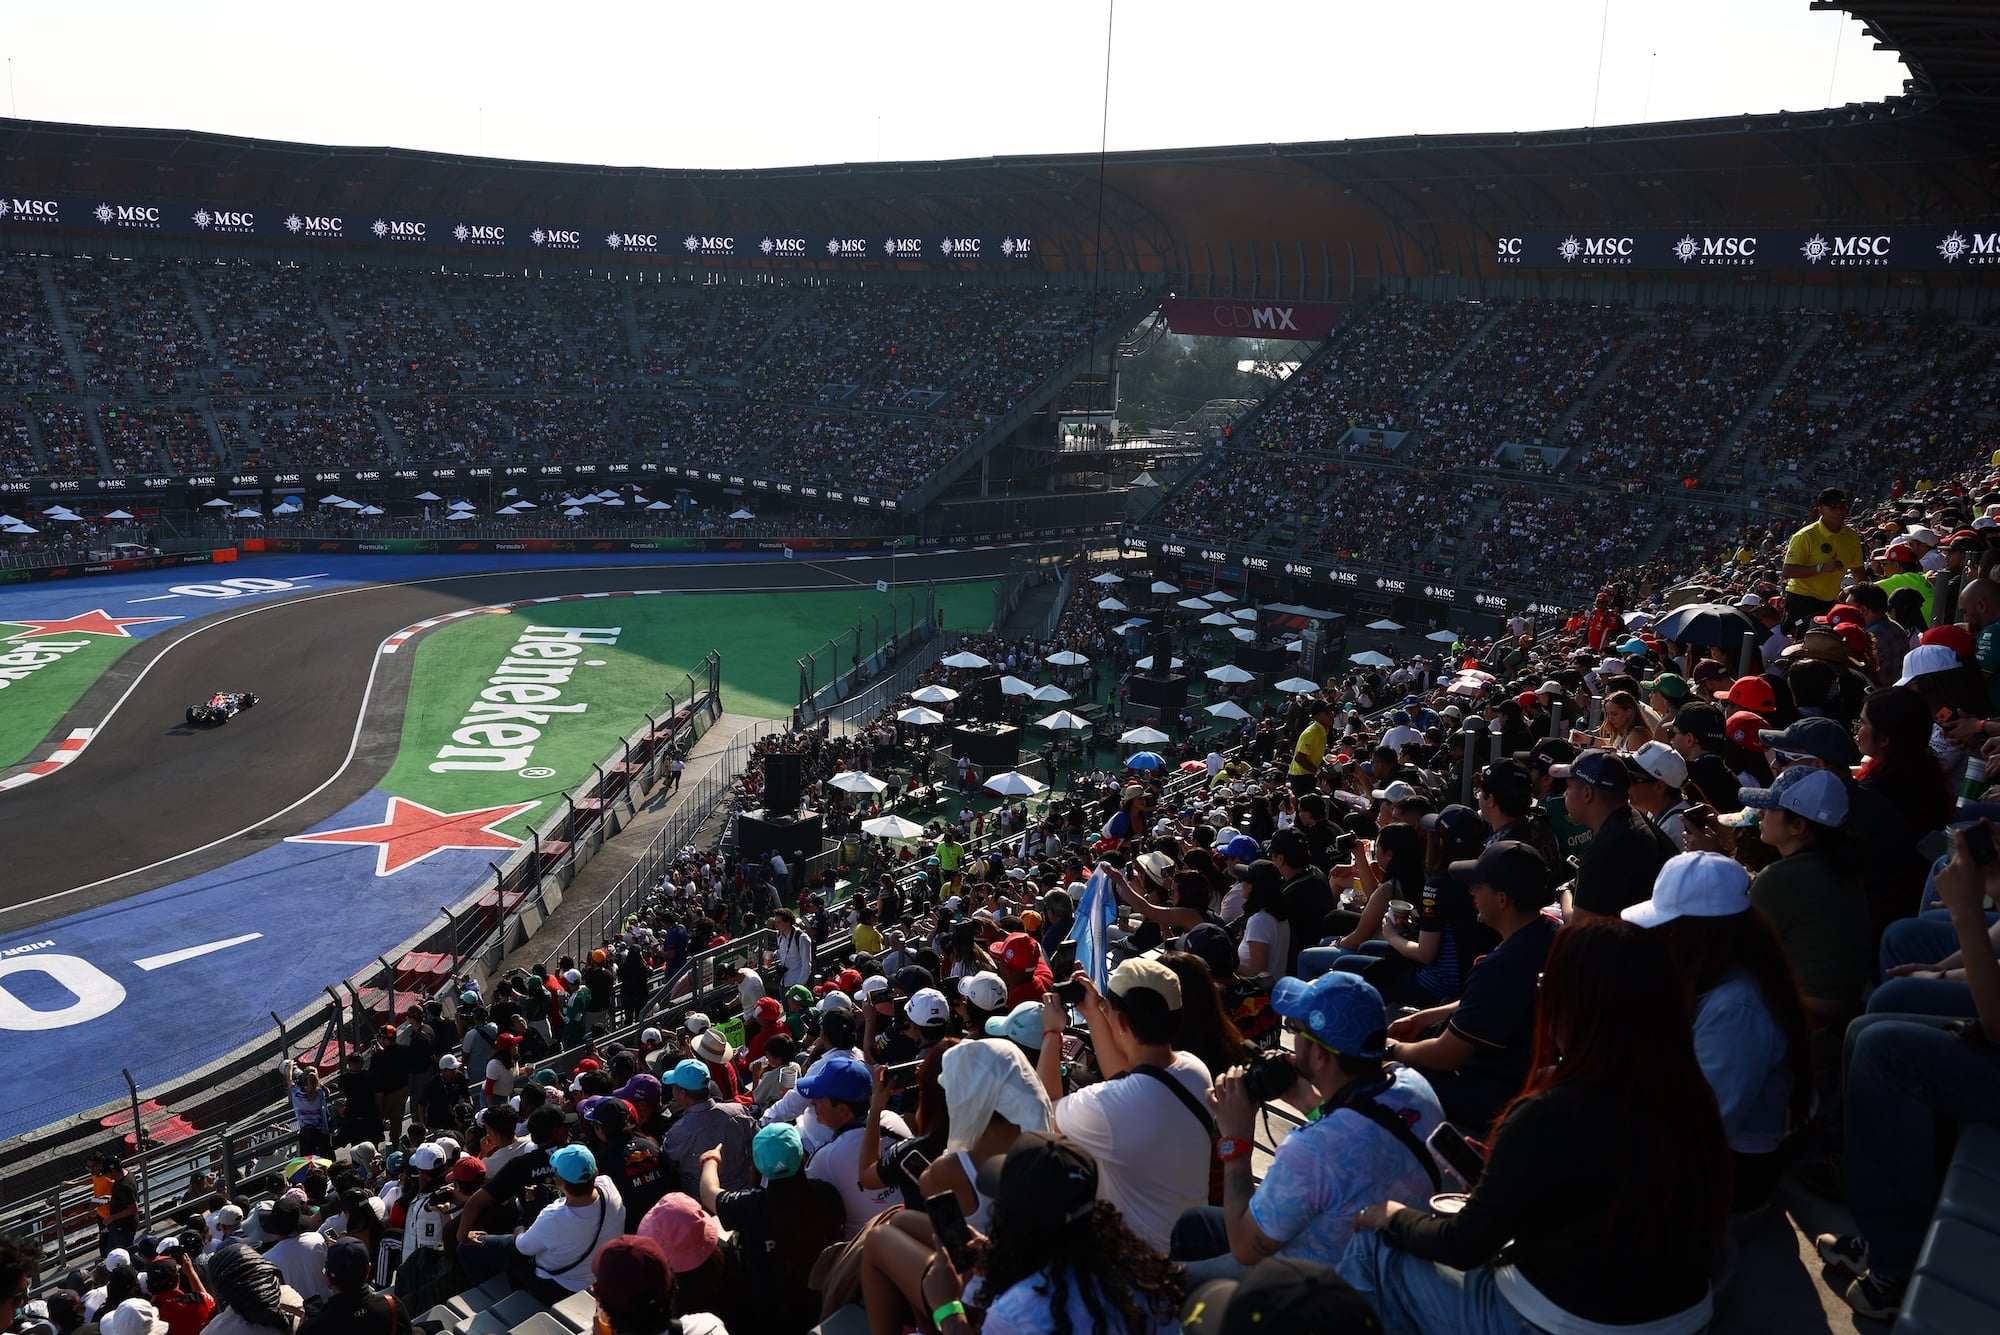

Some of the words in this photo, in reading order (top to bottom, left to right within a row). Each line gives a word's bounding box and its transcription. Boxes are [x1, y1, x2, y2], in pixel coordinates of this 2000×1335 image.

[13, 200, 58, 216] MSC
[117, 206, 160, 221] MSC
[14, 215, 60, 223] CRUISES
[214, 211, 254, 226] MSC
[305, 216, 342, 231] MSC
[118, 221, 161, 229] CRUISES
[390, 221, 426, 235] MSC
[471, 225, 505, 239] MSC
[547, 230, 580, 244] MSC
[624, 234, 657, 247] MSC
[701, 236, 734, 250] MSC
[775, 239, 805, 252] MSC
[841, 239, 866, 252] MSC
[897, 239, 921, 252] MSC
[954, 239, 981, 252] MSC
[1583, 238, 1634, 255] MSC
[1702, 237, 1756, 256] MSC
[1832, 236, 1891, 256] MSC
[1213, 305, 1297, 331] CDMX
[282, 474, 300, 482] MSC
[440, 469, 456, 477] MSC
[476, 468, 492, 476] MSC
[59, 481, 79, 489] MSC
[107, 479, 126, 487] MSC
[153, 478, 171, 486] MSC
[197, 477, 215, 485] MSC
[240, 475, 258, 483] MSC
[10, 482, 31, 490] MSC
[1130, 538, 1147, 548] MSC
[1169, 545, 1186, 555] MSC
[1209, 551, 1226, 561] MSC
[1250, 557, 1268, 567] MSC
[85, 565, 108, 573] Formula
[1293, 564, 1312, 575] MSC
[1338, 572, 1357, 582] MSC
[1385, 579, 1405, 590] MSC
[1434, 587, 1455, 598] MSC
[1486, 595, 1507, 607] MSC
[1540, 603, 1561, 614] MSC
[428, 625, 622, 774] Heineken
[0, 939, 56, 957] HIDR
[531, 1166, 556, 1178] HAM
[878, 1184, 900, 1200] CRO
